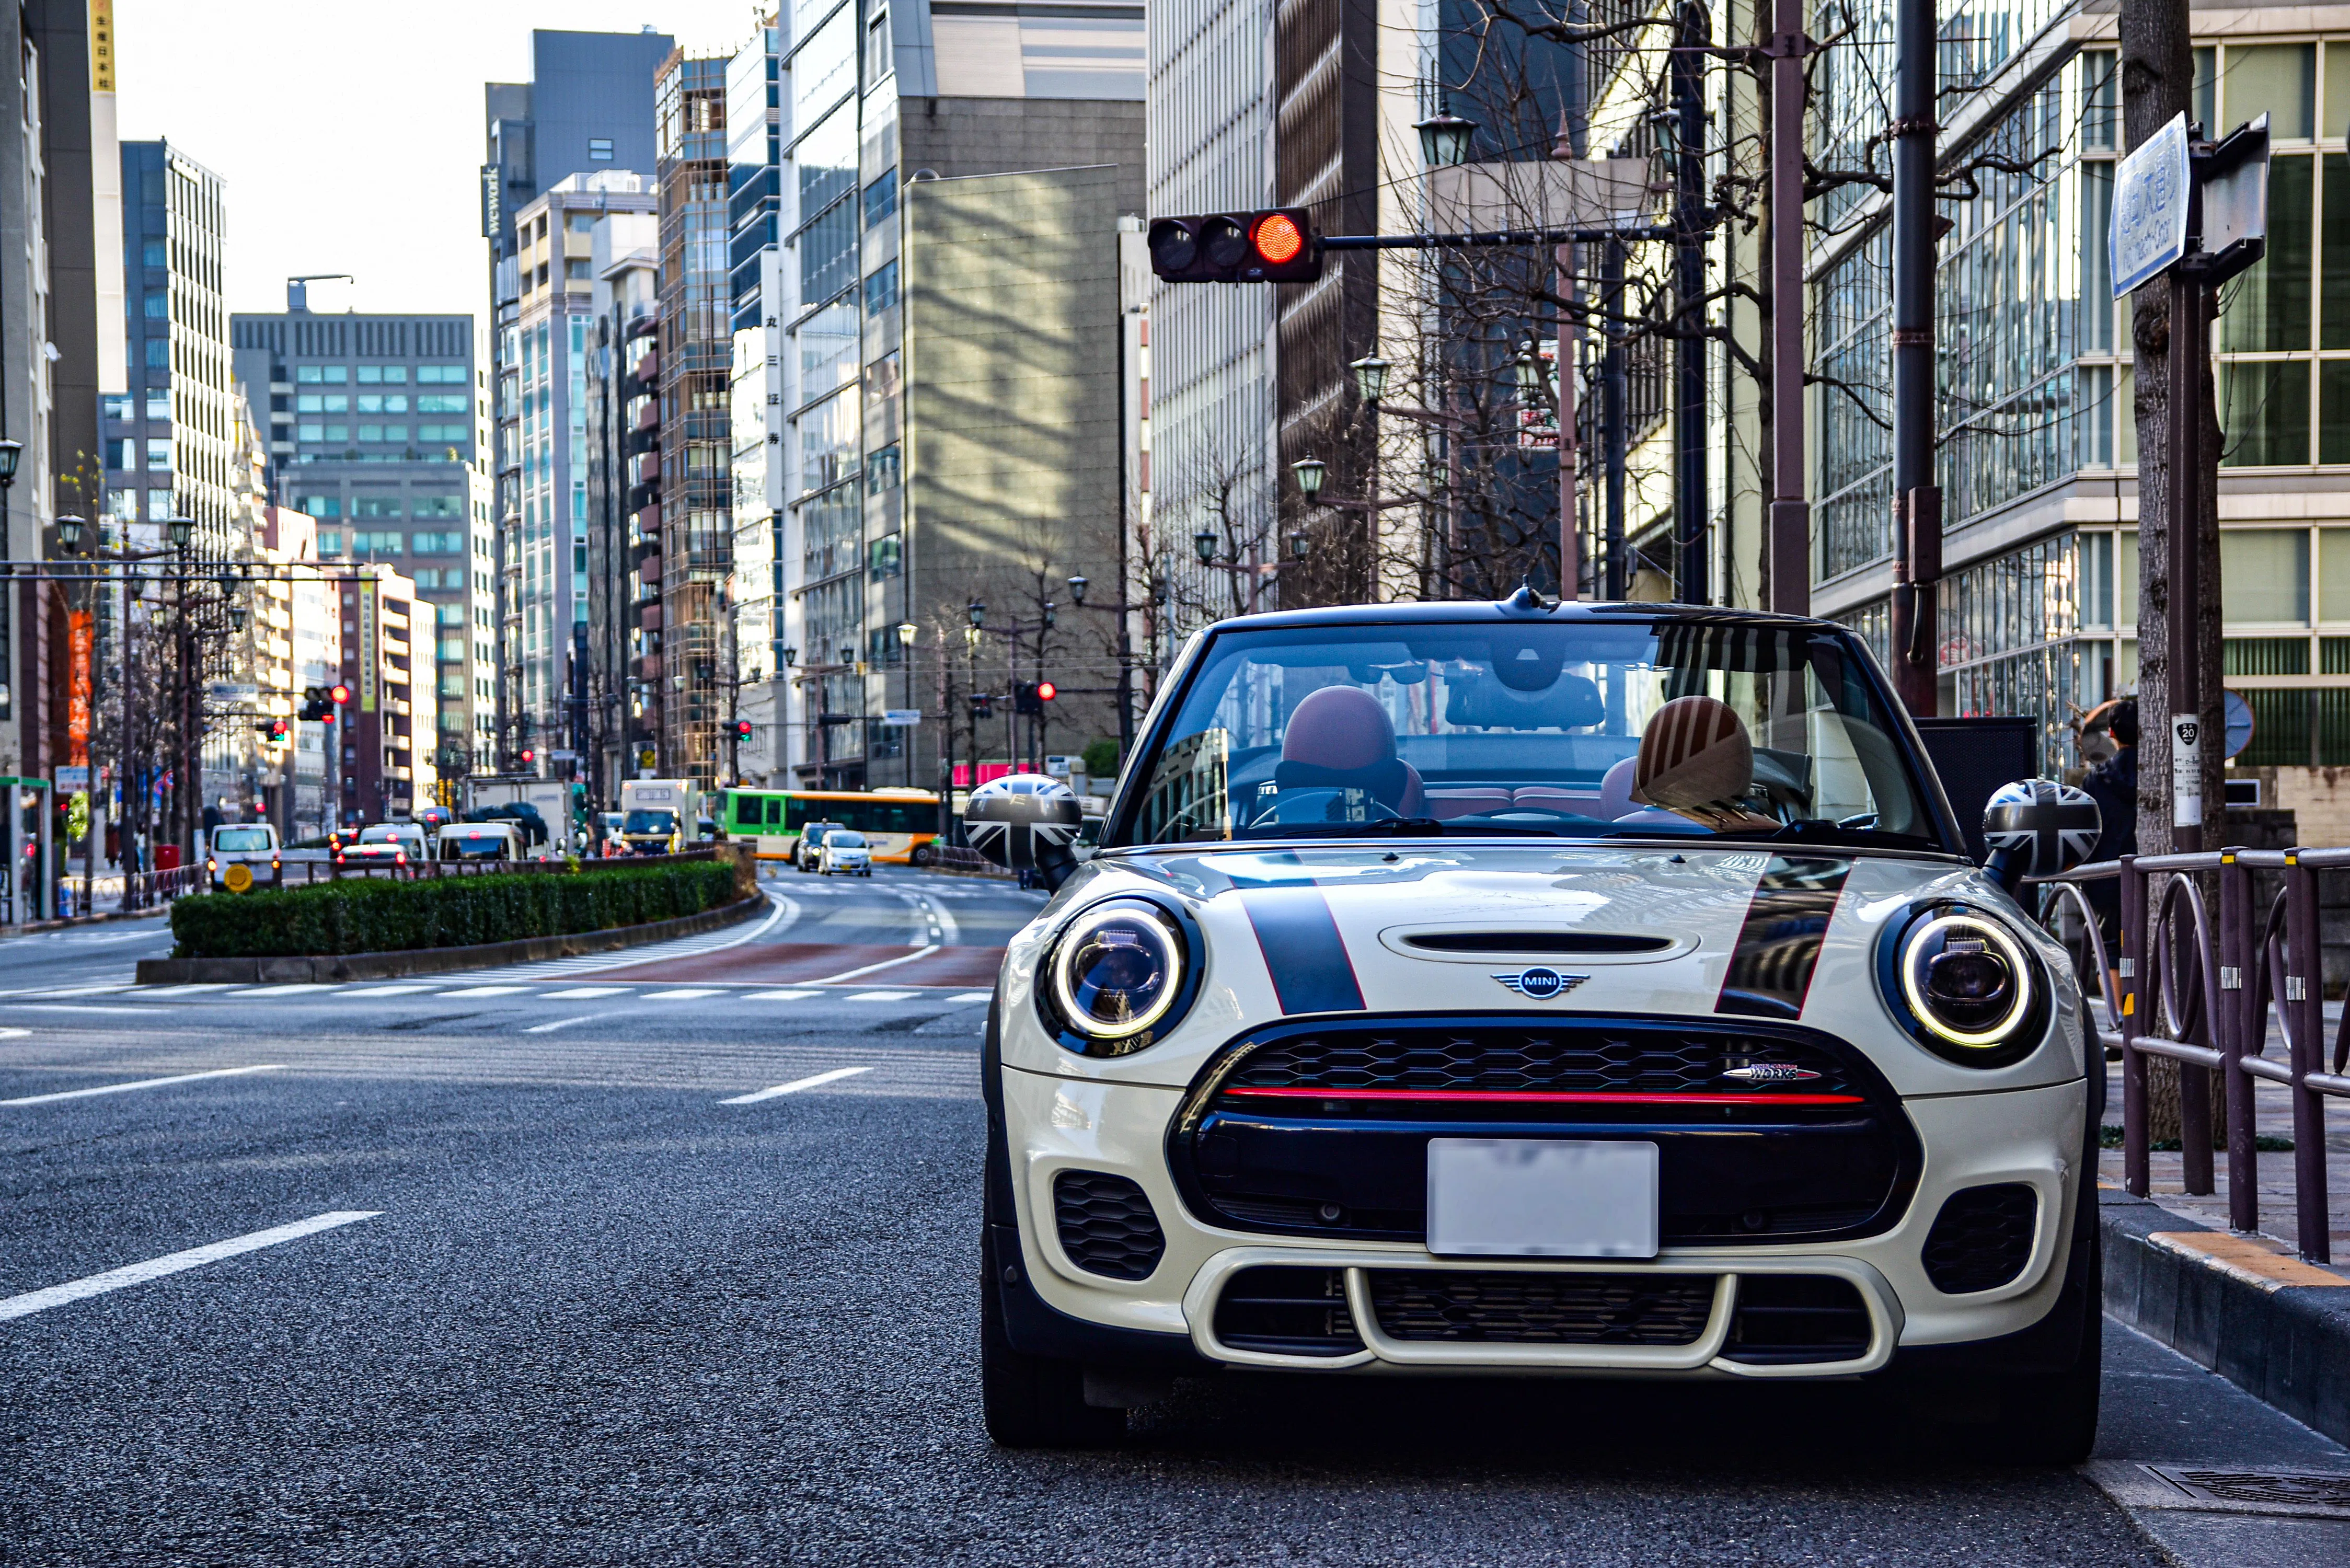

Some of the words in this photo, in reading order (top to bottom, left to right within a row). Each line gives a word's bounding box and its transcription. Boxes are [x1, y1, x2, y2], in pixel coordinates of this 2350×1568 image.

[481, 167, 500, 236] wework
[766, 315, 780, 445] 丸三証券
[2182, 729, 2194, 737] 20
[1524, 977, 1557, 985] MINI
[1751, 1068, 1798, 1079] WORKS
